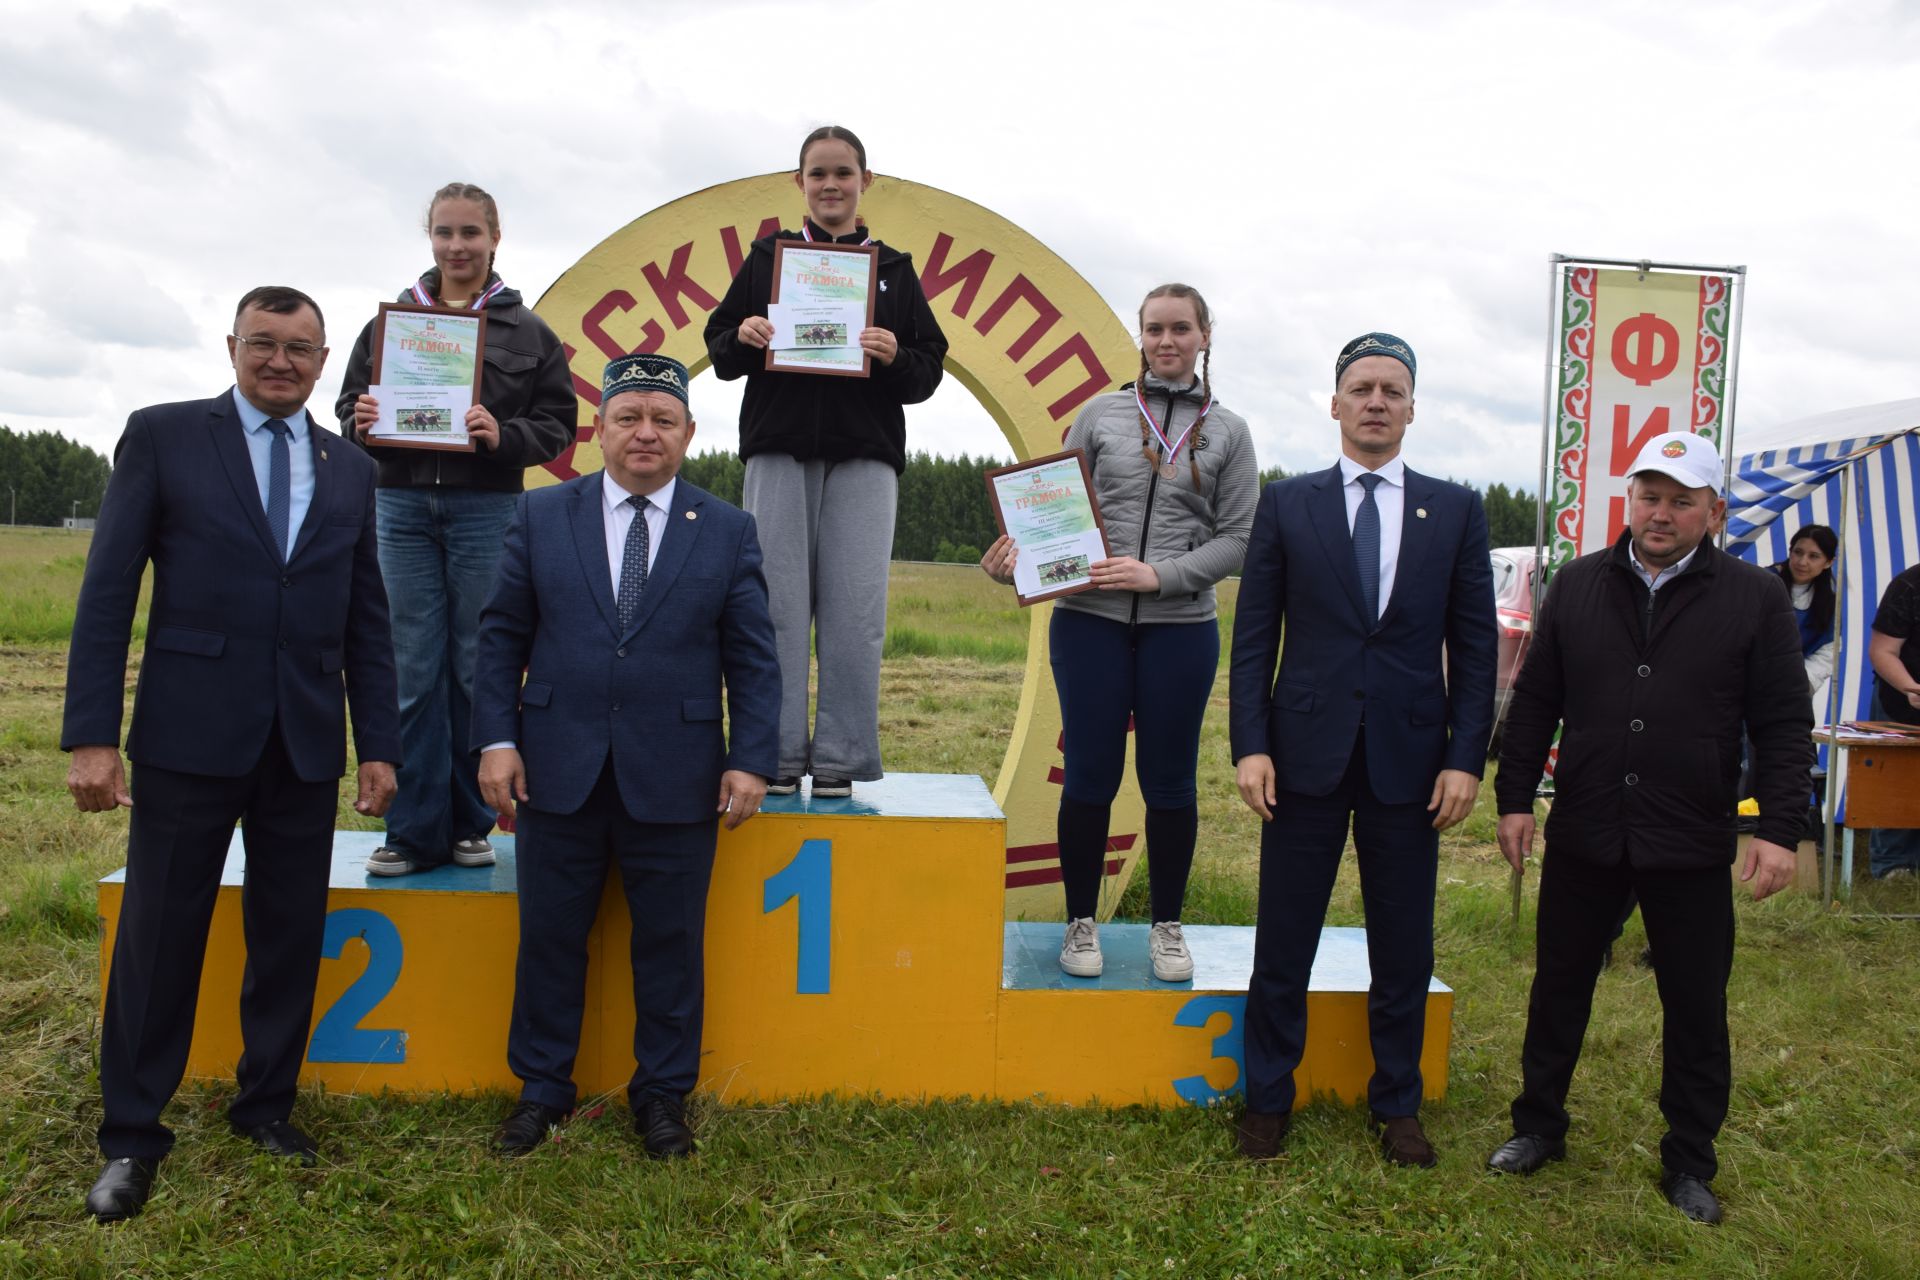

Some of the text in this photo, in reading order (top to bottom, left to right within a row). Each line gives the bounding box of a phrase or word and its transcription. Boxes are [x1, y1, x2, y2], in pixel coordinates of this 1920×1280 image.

[796, 273, 854, 287] ГРАМОТА
[400, 339, 461, 354] ГРАМОТА
[1606, 313, 1680, 548] ФИ
[1015, 487, 1071, 509] ГРАМОТА
[763, 839, 832, 994] 1
[307, 908, 404, 1063] 2
[1171, 995, 1247, 1108] 3
